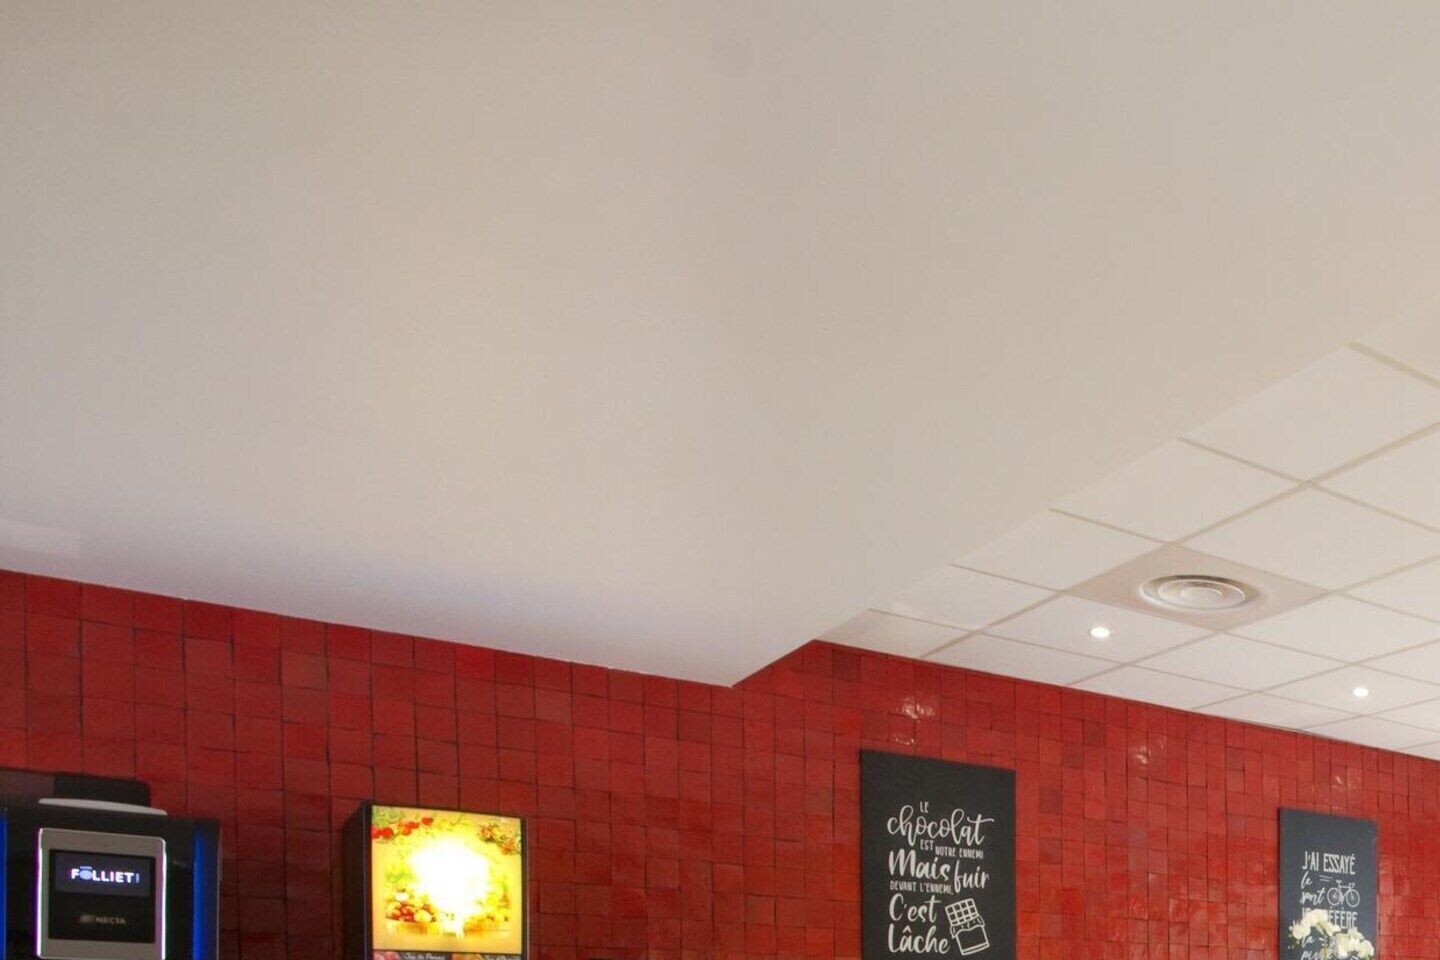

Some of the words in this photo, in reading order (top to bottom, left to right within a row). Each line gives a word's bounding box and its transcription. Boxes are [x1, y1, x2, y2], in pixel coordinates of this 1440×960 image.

[919, 801, 930, 814] LE
[887, 804, 995, 847] chocolat
[920, 839, 934, 851] EST
[935, 845, 956, 858] NOTRE
[888, 848, 951, 881] Mais
[954, 860, 990, 894] fuir
[1302, 851, 1320, 871] J'AI
[1323, 853, 1356, 875] ESSAYÉ
[889, 880, 917, 892] DEVANT
[1300, 887, 1326, 905] sport
[888, 893, 941, 923] C'est
[95, 915, 126, 925] NECTA
